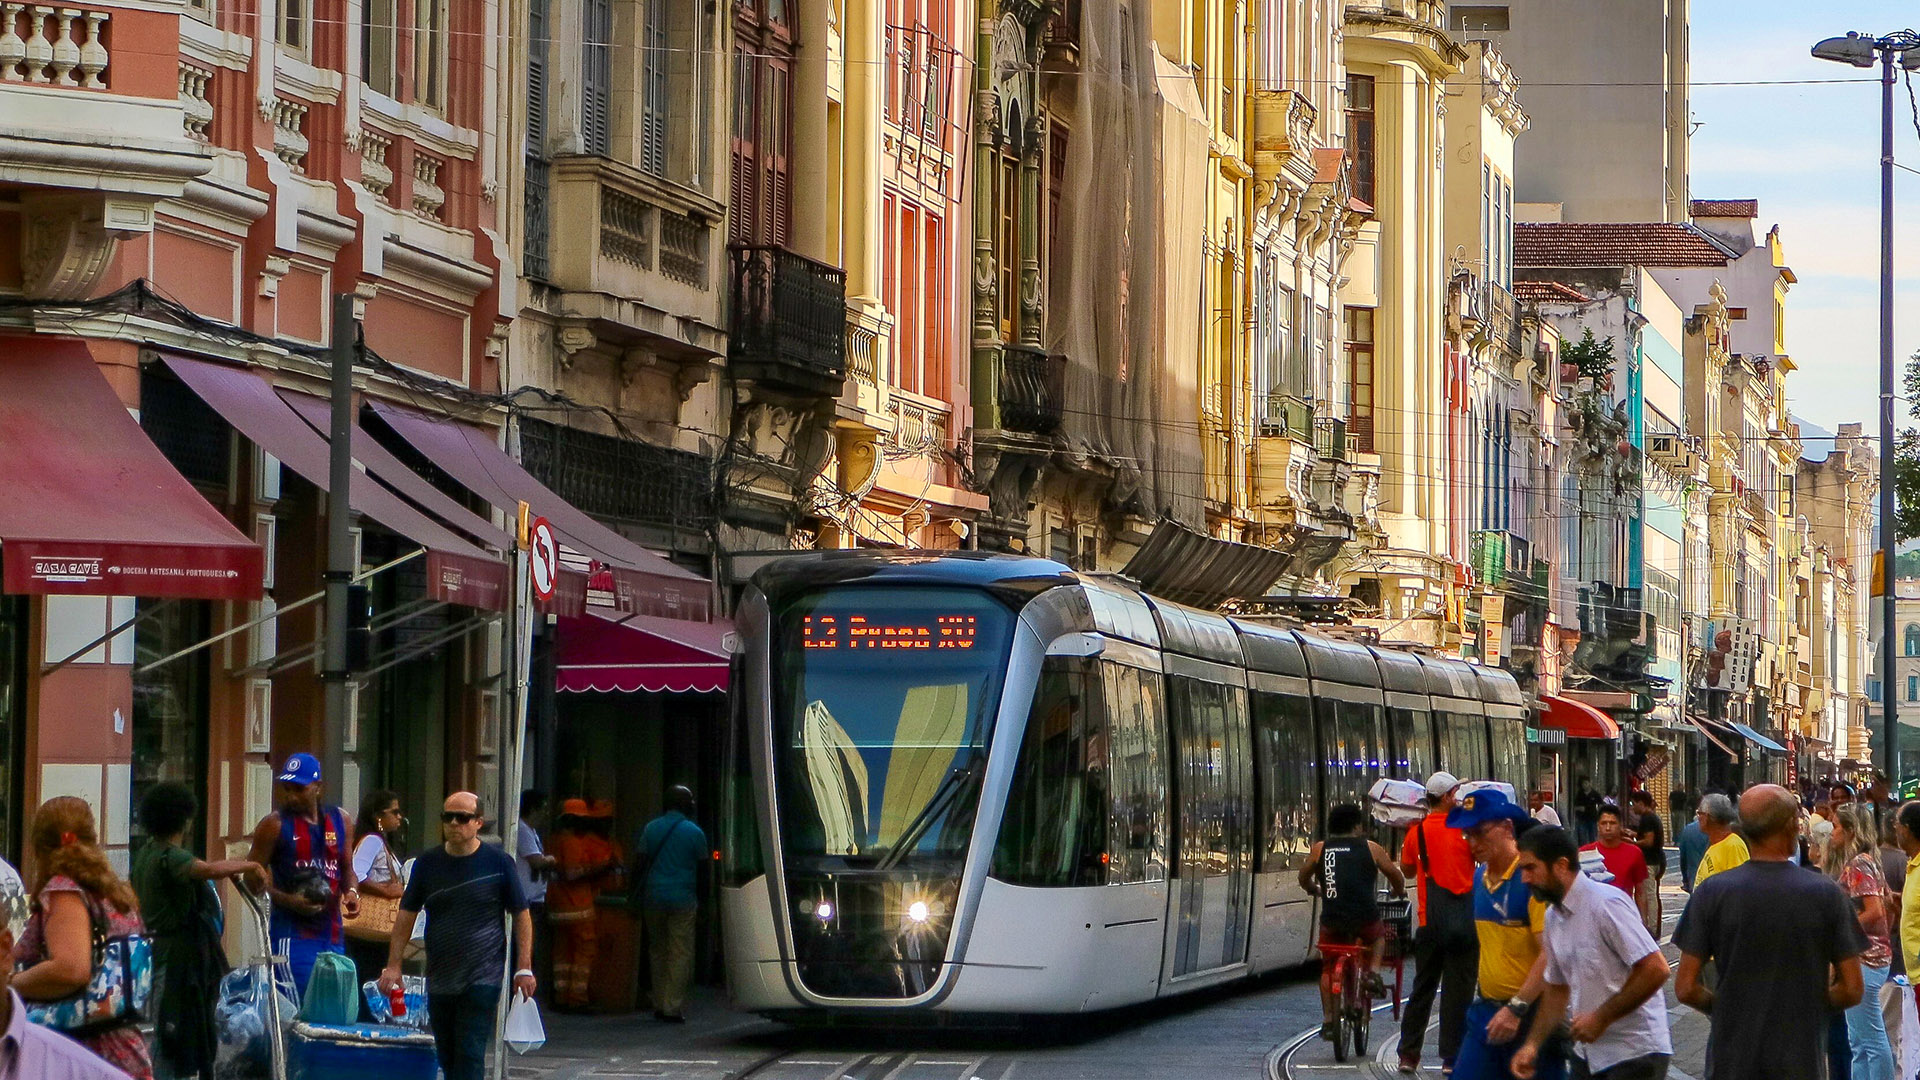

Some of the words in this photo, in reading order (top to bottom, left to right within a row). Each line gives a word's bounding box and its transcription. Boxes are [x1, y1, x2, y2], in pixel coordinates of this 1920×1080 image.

[34, 562, 67, 574] CASA
[68, 560, 99, 575] CAVÉ
[122, 567, 147, 575] DOCERIA
[150, 567, 185, 576] ARTESANAL
[186, 569, 227, 577] PORTUGUESA
[1324, 852, 1337, 899] SHAPES
